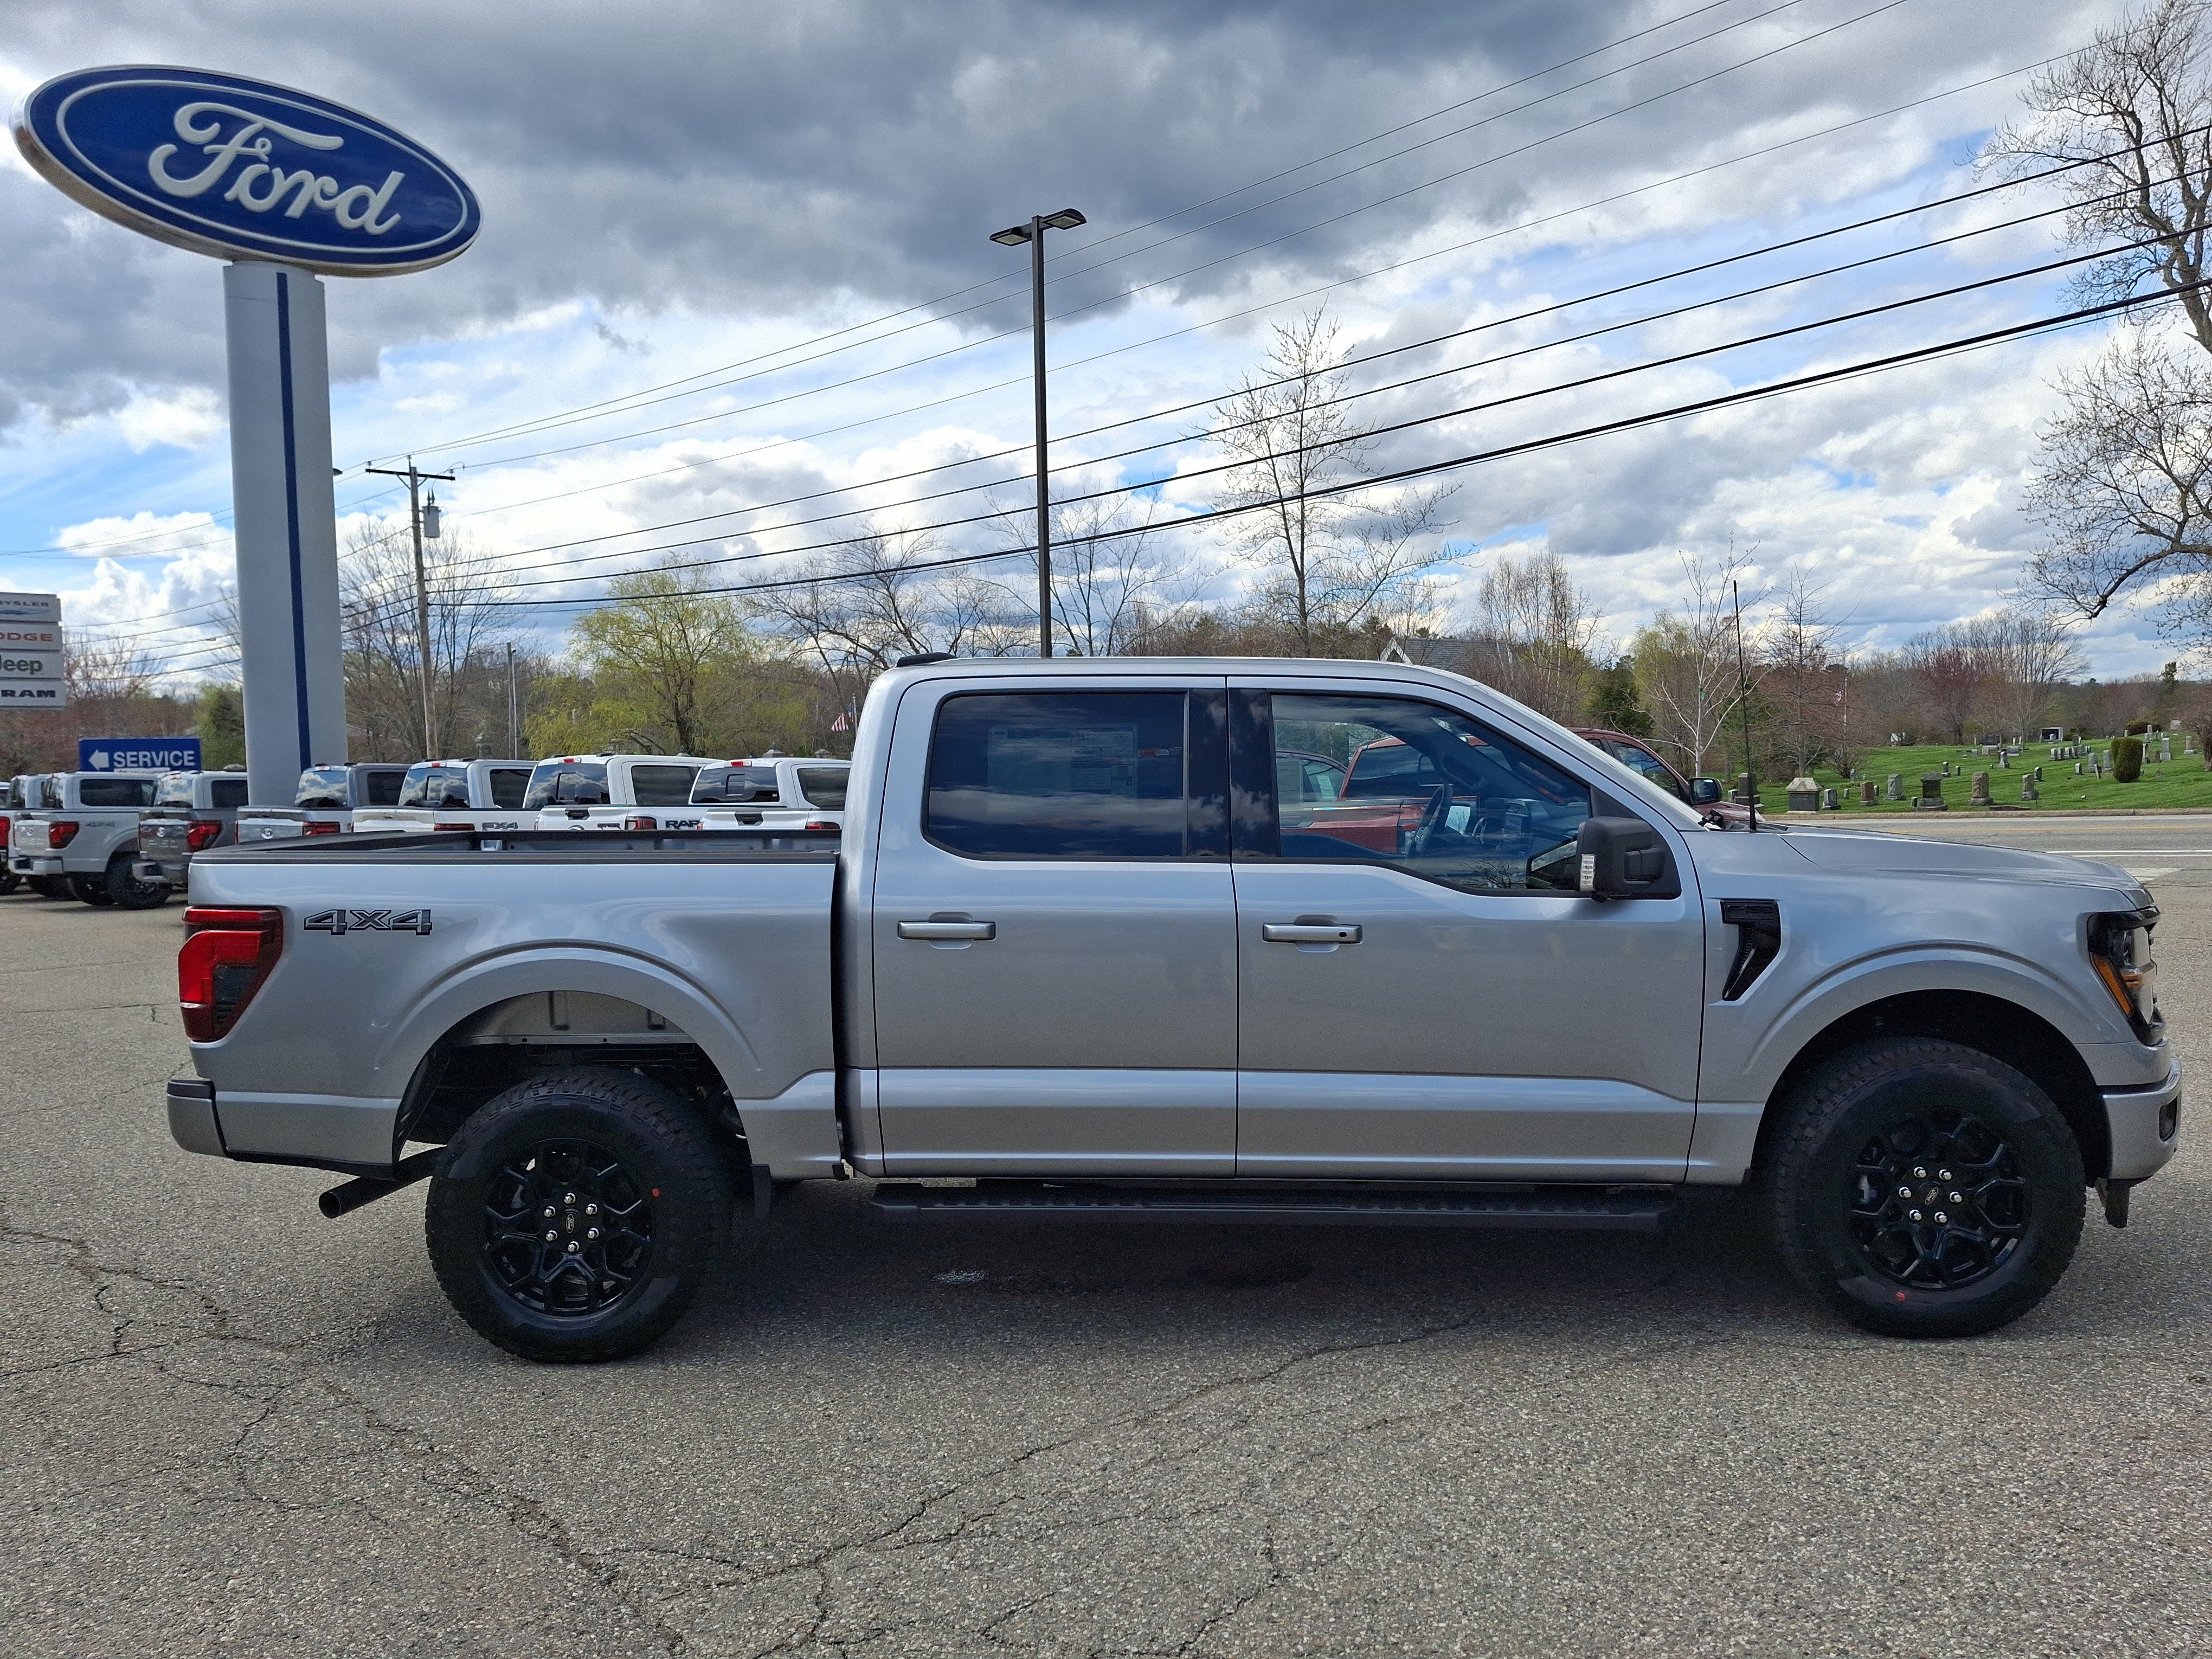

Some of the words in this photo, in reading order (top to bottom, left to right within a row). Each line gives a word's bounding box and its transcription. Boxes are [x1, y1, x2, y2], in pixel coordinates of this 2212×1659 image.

[148, 101, 405, 236] Ford
[1, 690, 56, 698] RAM
[113, 750, 195, 767] SERVICE
[481, 822, 518, 831] FX4
[303, 908, 433, 936] 4X4
